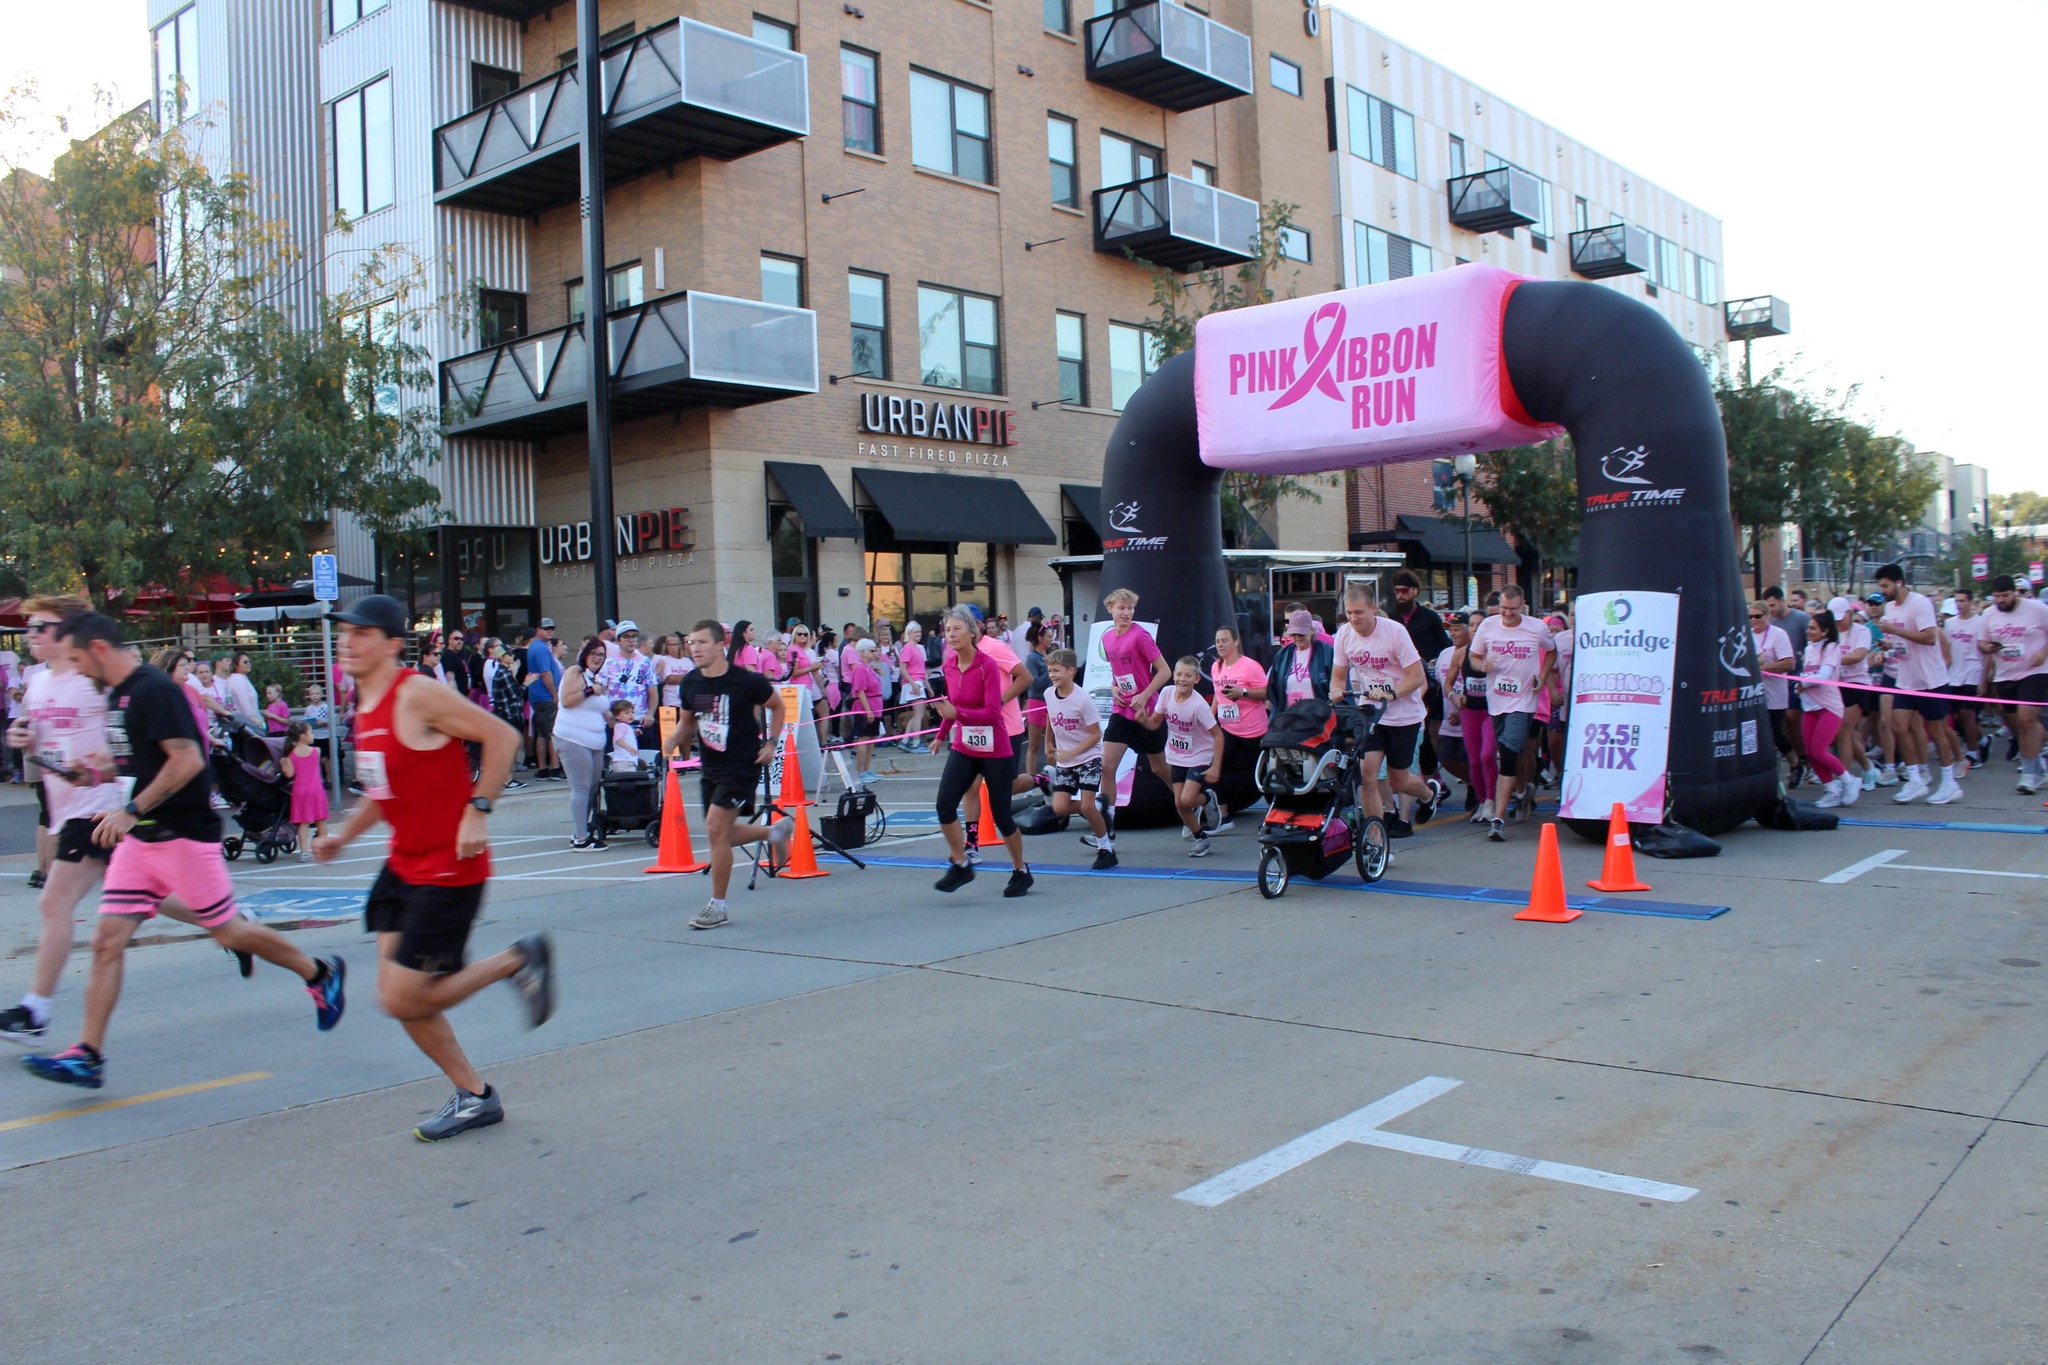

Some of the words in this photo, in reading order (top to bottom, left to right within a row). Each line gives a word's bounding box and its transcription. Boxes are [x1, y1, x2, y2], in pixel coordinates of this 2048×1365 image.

[1229, 346, 1298, 395] PINK
[1352, 376, 1416, 430] RUN
[858, 442, 899, 457] FAST
[909, 447, 956, 463] FIRED
[965, 452, 1009, 467] PIZZA
[1586, 490, 1631, 507] TRUE
[1631, 488, 1686, 501] TIME
[1623, 499, 1681, 508] SERVICES
[1127, 536, 1168, 546] TIME
[554, 564, 587, 578] FAST
[649, 552, 696, 569] PIZZA
[1580, 629, 1671, 652] Oakridge
[1497, 683, 1518, 694] 1432
[1222, 710, 1235, 719] 431
[967, 735, 987, 747] 430
[1171, 738, 1189, 750] 1497
[1584, 723, 1630, 746] 93.5
[1632, 725, 1640, 746] THE
[1581, 746, 1638, 770] MIX
